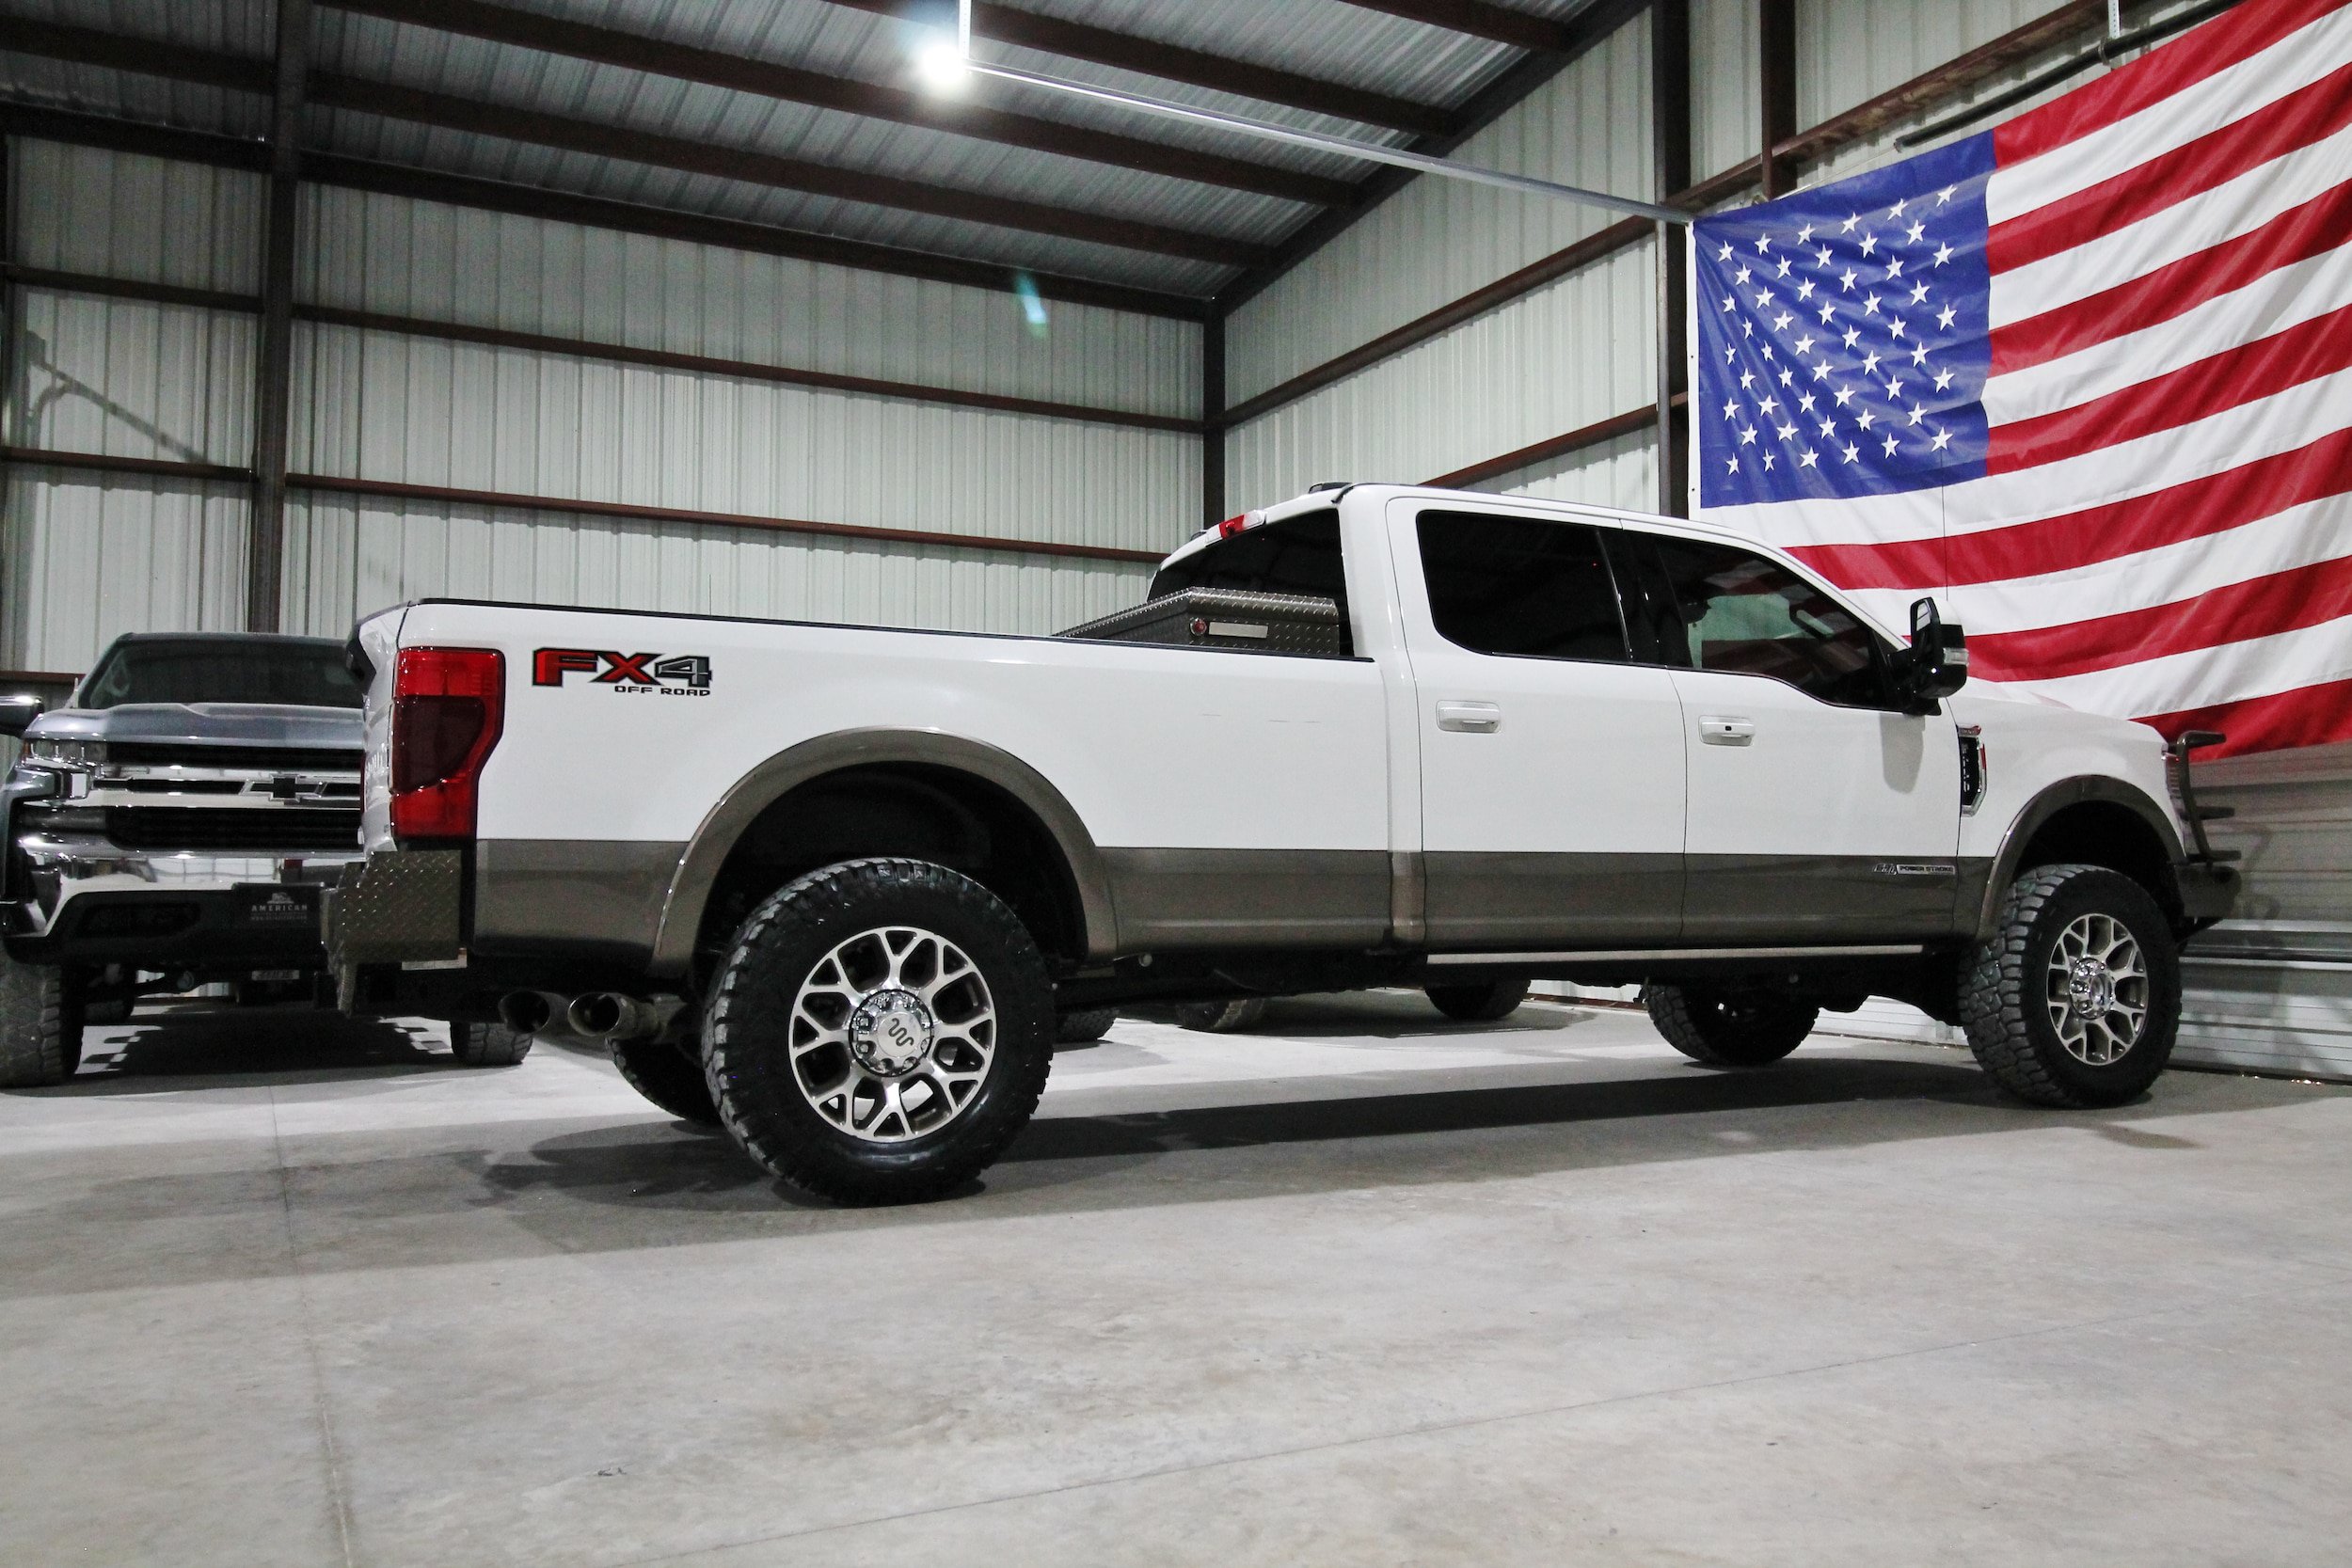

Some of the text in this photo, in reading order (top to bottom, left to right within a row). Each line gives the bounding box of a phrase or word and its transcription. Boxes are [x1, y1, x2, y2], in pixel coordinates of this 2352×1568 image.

[532, 646, 712, 688] FX4
[614, 685, 711, 697] OFF ROAD
[251, 904, 308, 912] AMERICAN
